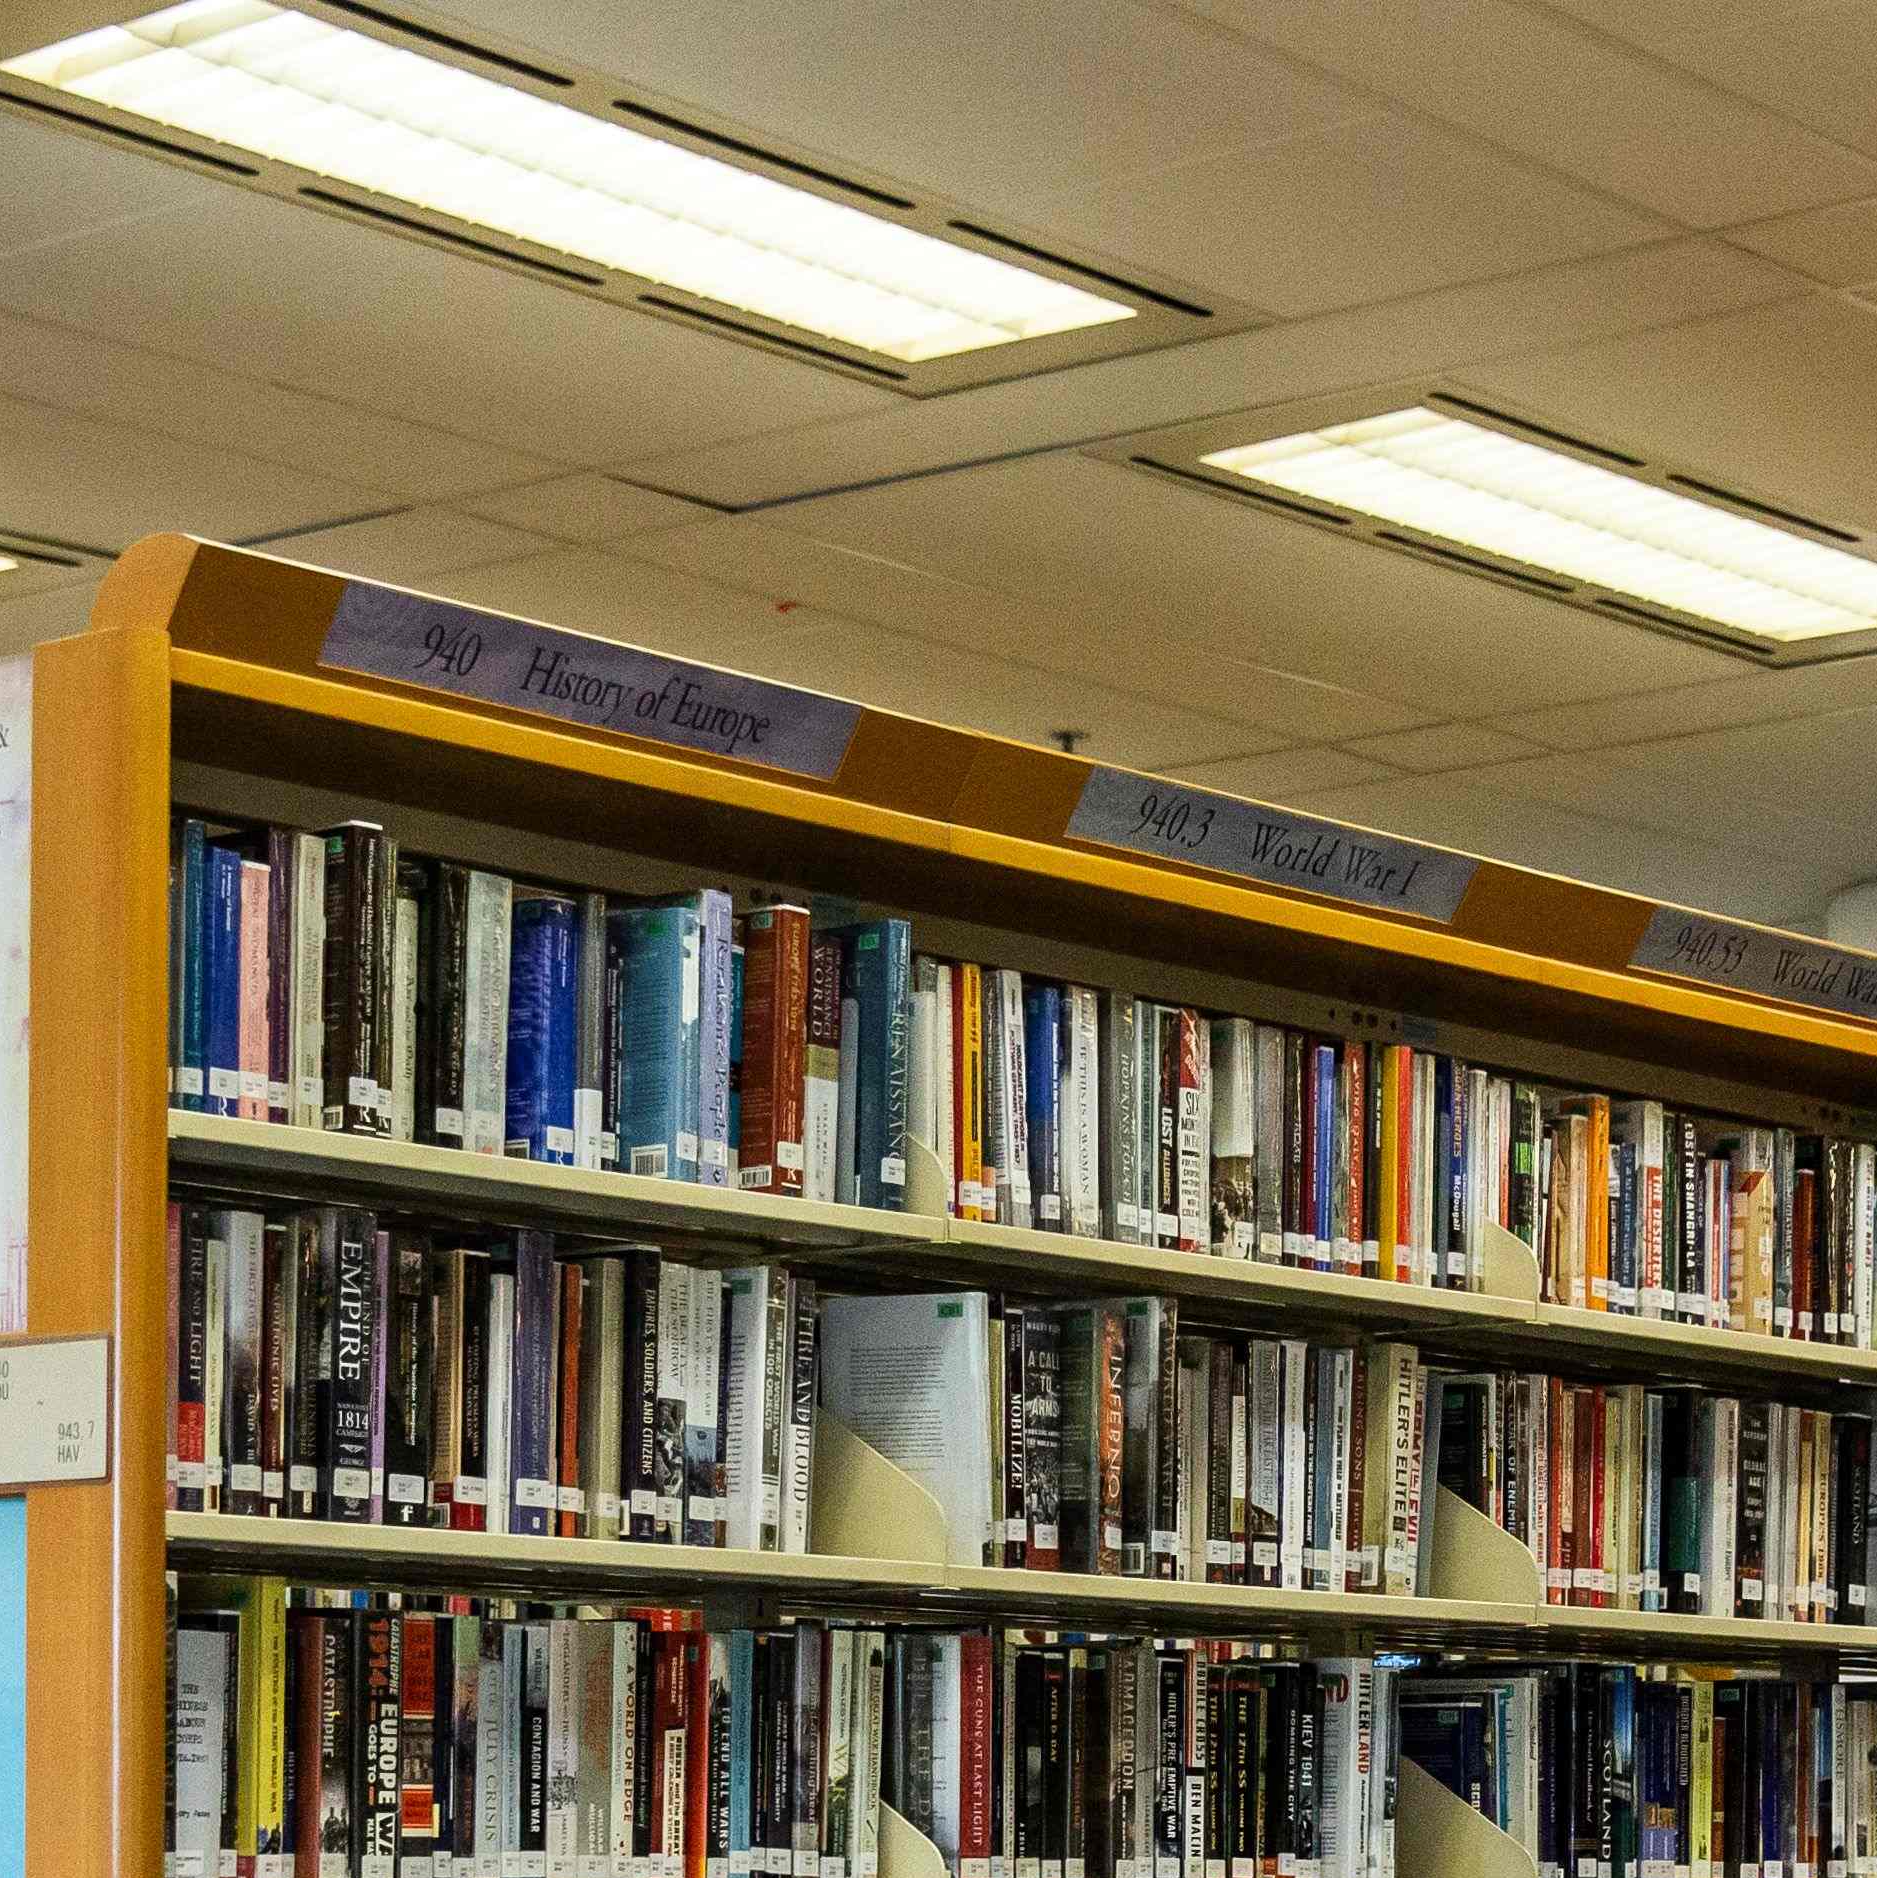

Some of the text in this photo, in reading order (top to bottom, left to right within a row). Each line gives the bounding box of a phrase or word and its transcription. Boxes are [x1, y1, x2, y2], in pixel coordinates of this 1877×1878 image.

[416, 625, 770, 755] 940 History of Europe
[1128, 794, 1216, 850] 940.3
[1250, 820, 1340, 876] World
[1344, 843, 1394, 895] War
[1664, 925, 1749, 975] 940.53
[1772, 948, 1843, 995] World
[338, 1240, 364, 1381] EMPIRE
[57, 1444, 80, 1463] HAV
[336, 1409, 370, 1431] 1814
[793, 1315, 815, 1502] FIRE AND BLOOD
[1009, 1392, 1023, 1491] MOBILIZE!
[1105, 1355, 1123, 1500] INFERNO
[1394, 1356, 1413, 1518] HITLER'S ELITE
[378, 1703, 399, 1805] EUROPE
[529, 1716, 543, 1834] CONTAGION AND WAR
[1301, 1713, 1314, 1787] KIEV 1941
[1357, 1672, 1371, 1775] HITLERLAND
[1601, 1738, 1614, 1861] SCOTLAND
